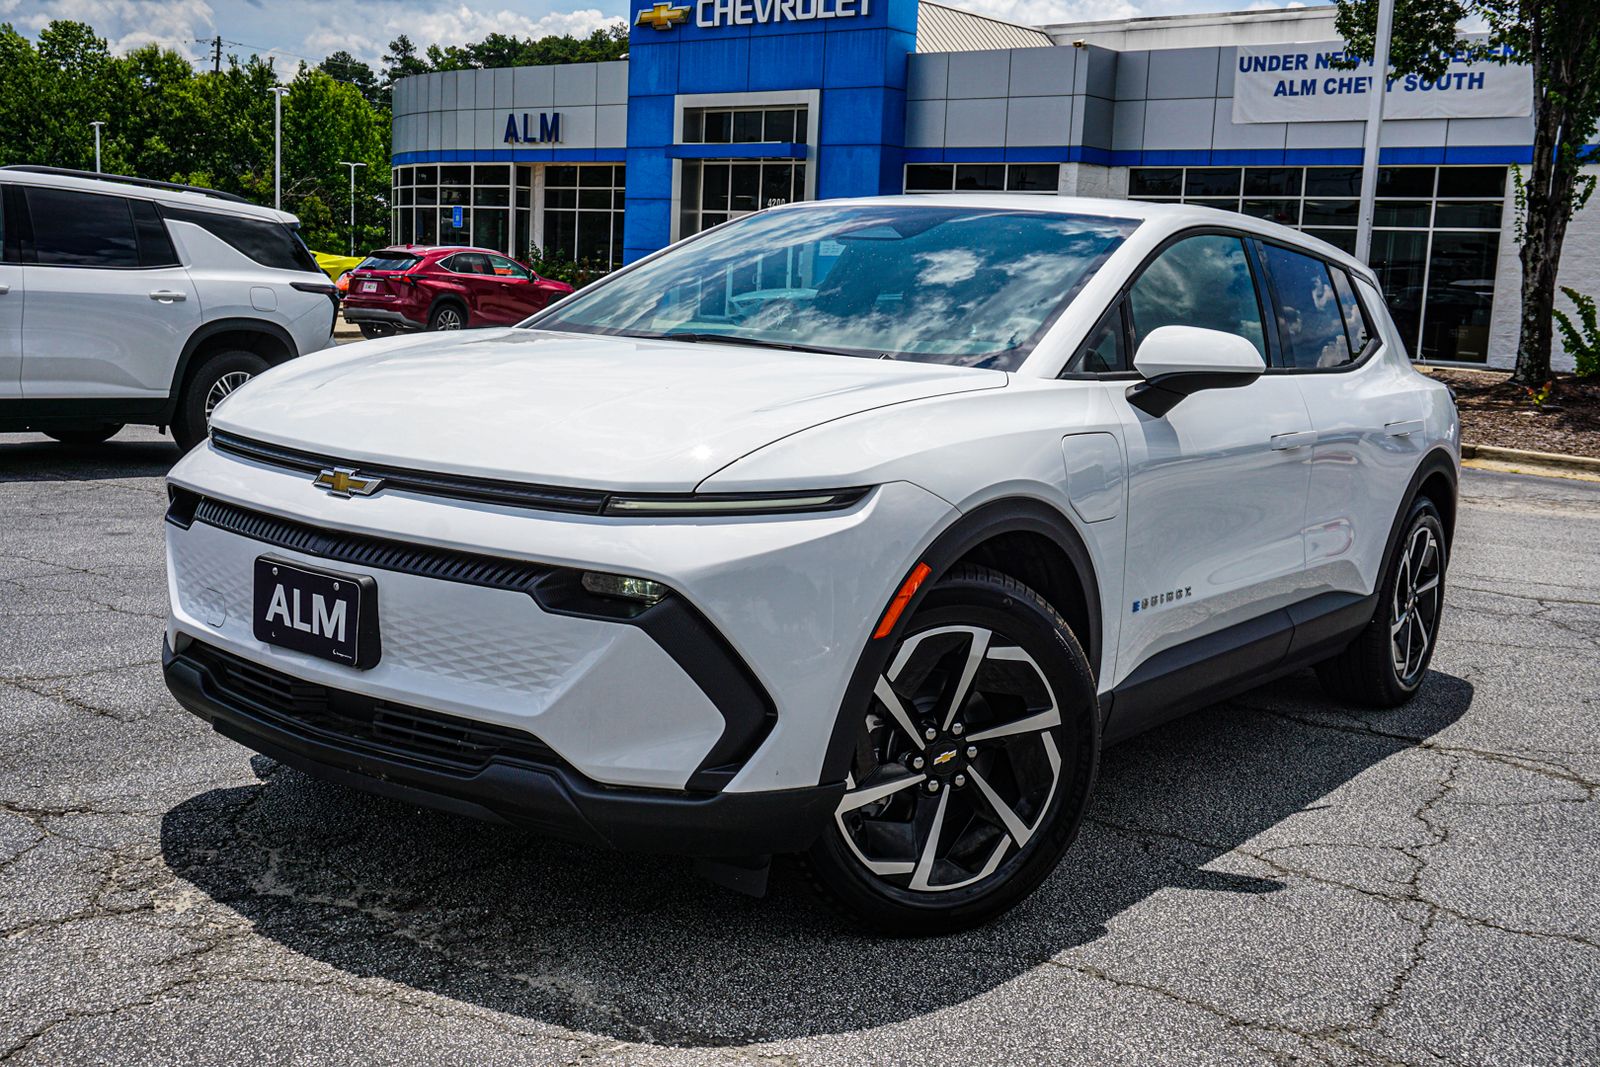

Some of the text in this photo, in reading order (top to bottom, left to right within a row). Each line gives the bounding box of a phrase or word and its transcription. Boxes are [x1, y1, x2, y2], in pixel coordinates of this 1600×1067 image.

[1239, 53, 1309, 73] UNDER
[1273, 79, 1317, 97] ALM
[1404, 72, 1485, 92] SOUTH
[504, 112, 561, 143] ALM
[265, 583, 347, 643] ALM
